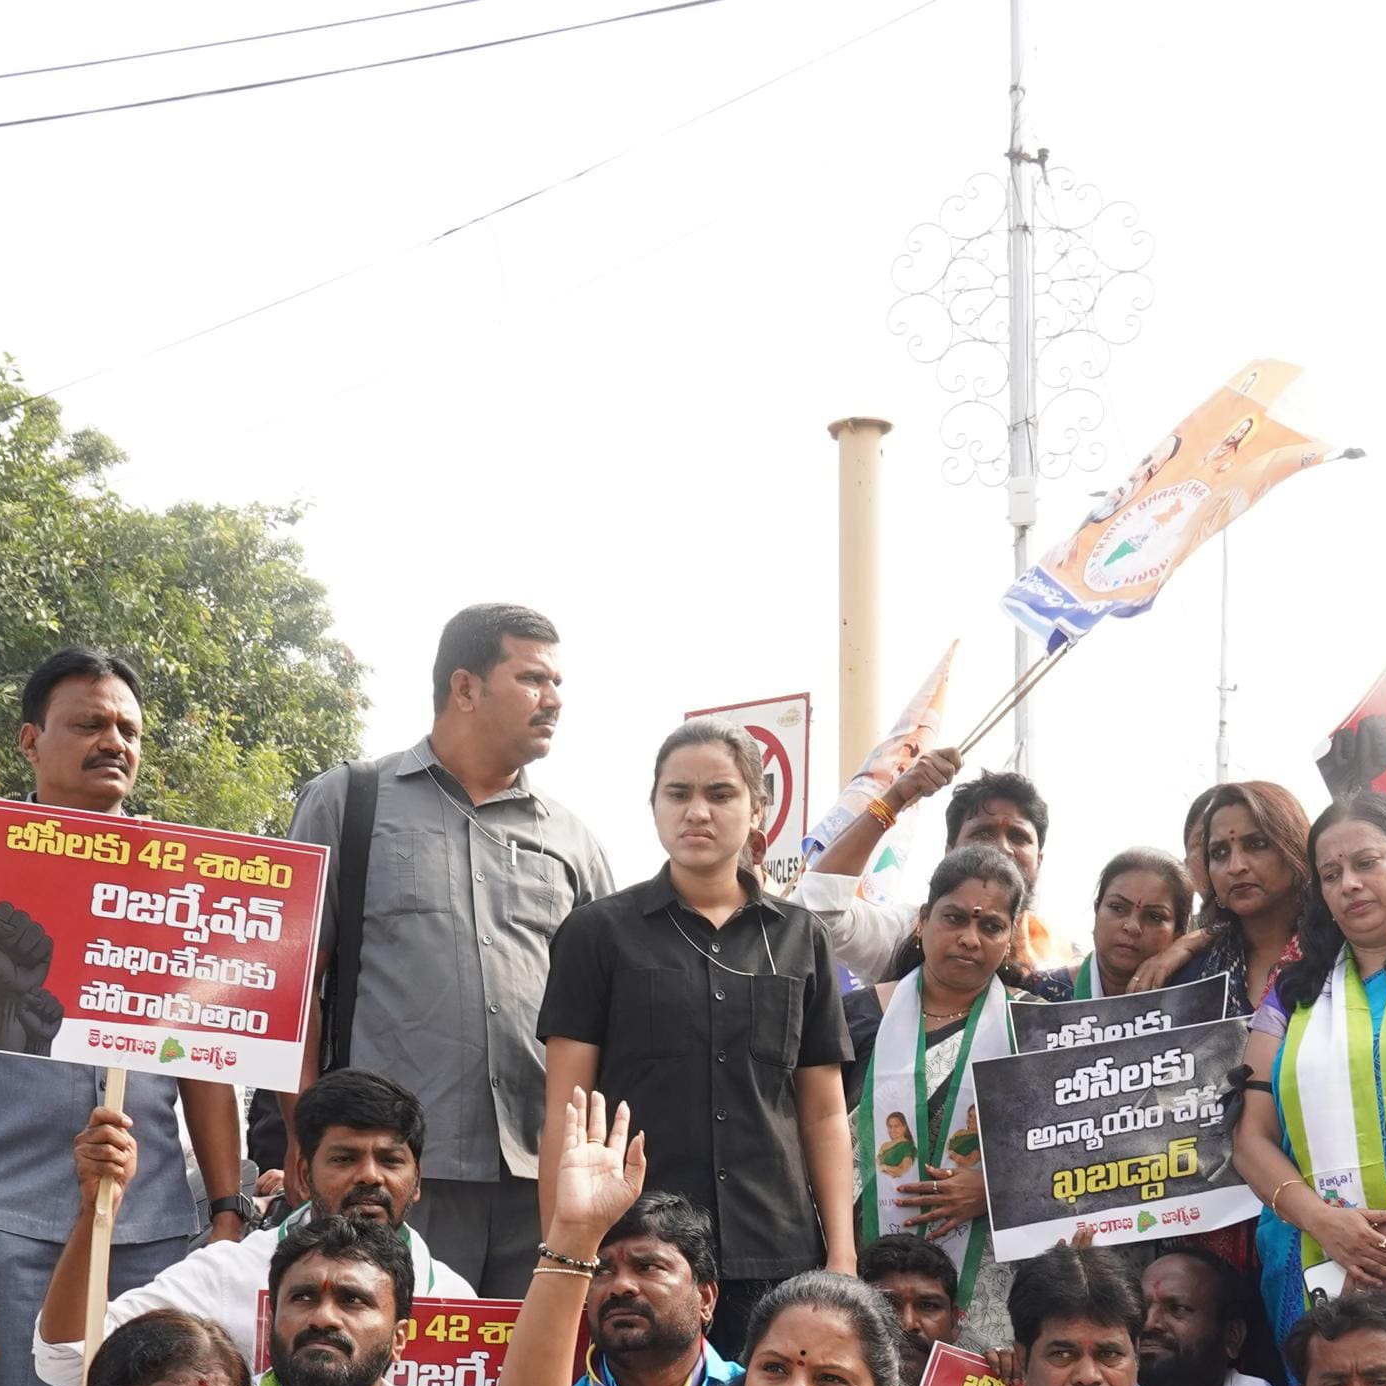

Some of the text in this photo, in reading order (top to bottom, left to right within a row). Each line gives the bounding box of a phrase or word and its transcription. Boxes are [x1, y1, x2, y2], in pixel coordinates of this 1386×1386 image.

[6, 819, 293, 889] బీసీలకు 42 శాతం
[91, 883, 284, 944] రిజర్వేషన్
[84, 938, 277, 991] సాధించేవరకు
[79, 980, 269, 1035] పోరాడుతాం
[88, 1029, 157, 1056] తెలంగాణ
[1054, 1047, 1196, 1106] బీసీలకు
[1026, 1102, 1165, 1152] అన్యాయం
[1052, 1136, 1199, 1205] ఖబడ్దార్
[425, 1315, 470, 1342] 42
